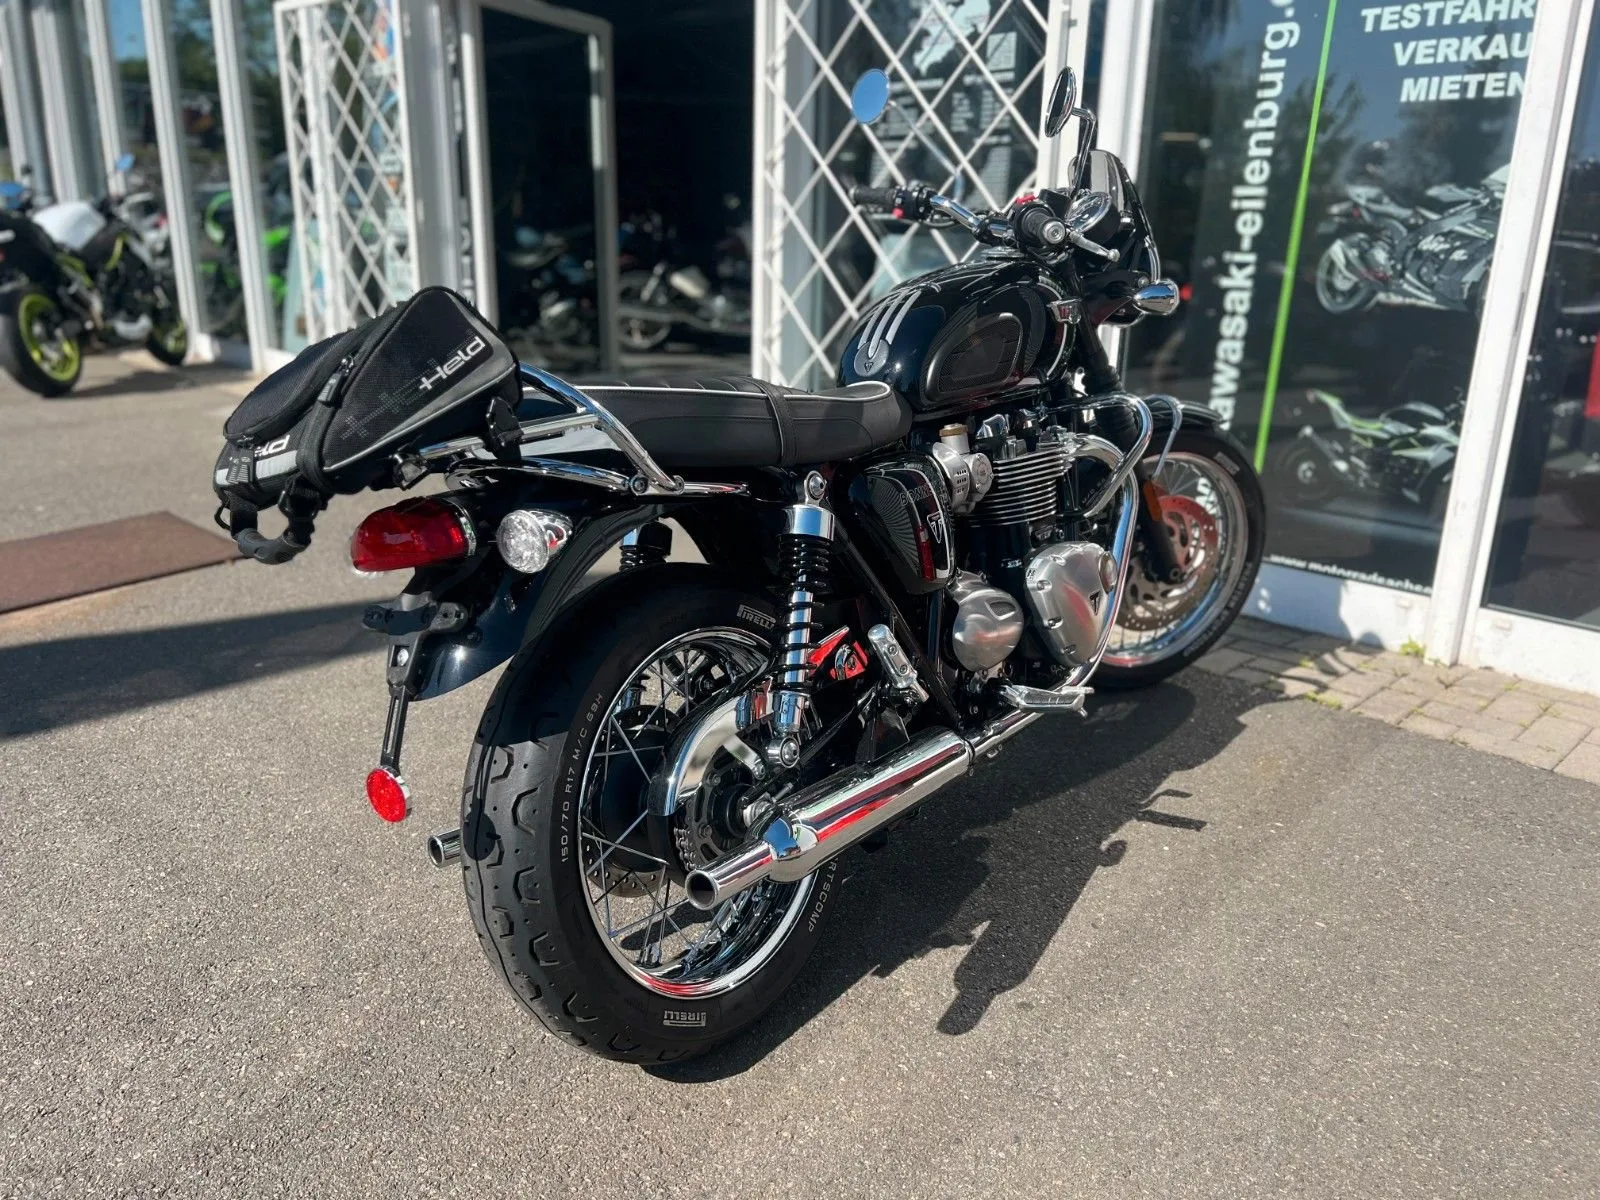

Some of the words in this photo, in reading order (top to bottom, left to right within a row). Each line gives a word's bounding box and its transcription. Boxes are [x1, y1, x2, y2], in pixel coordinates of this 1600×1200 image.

[1208, 0, 1300, 430] awasaki-eilenburg.
[419, 336, 485, 390] Held
[736, 604, 776, 630] PIRELLI
[572, 727, 588, 760] M/C
[564, 767, 575, 793] R17
[560, 801, 570, 862] 150/70
[808, 857, 839, 932] RTSCOMP
[663, 1010, 707, 1027] PIRELLI
